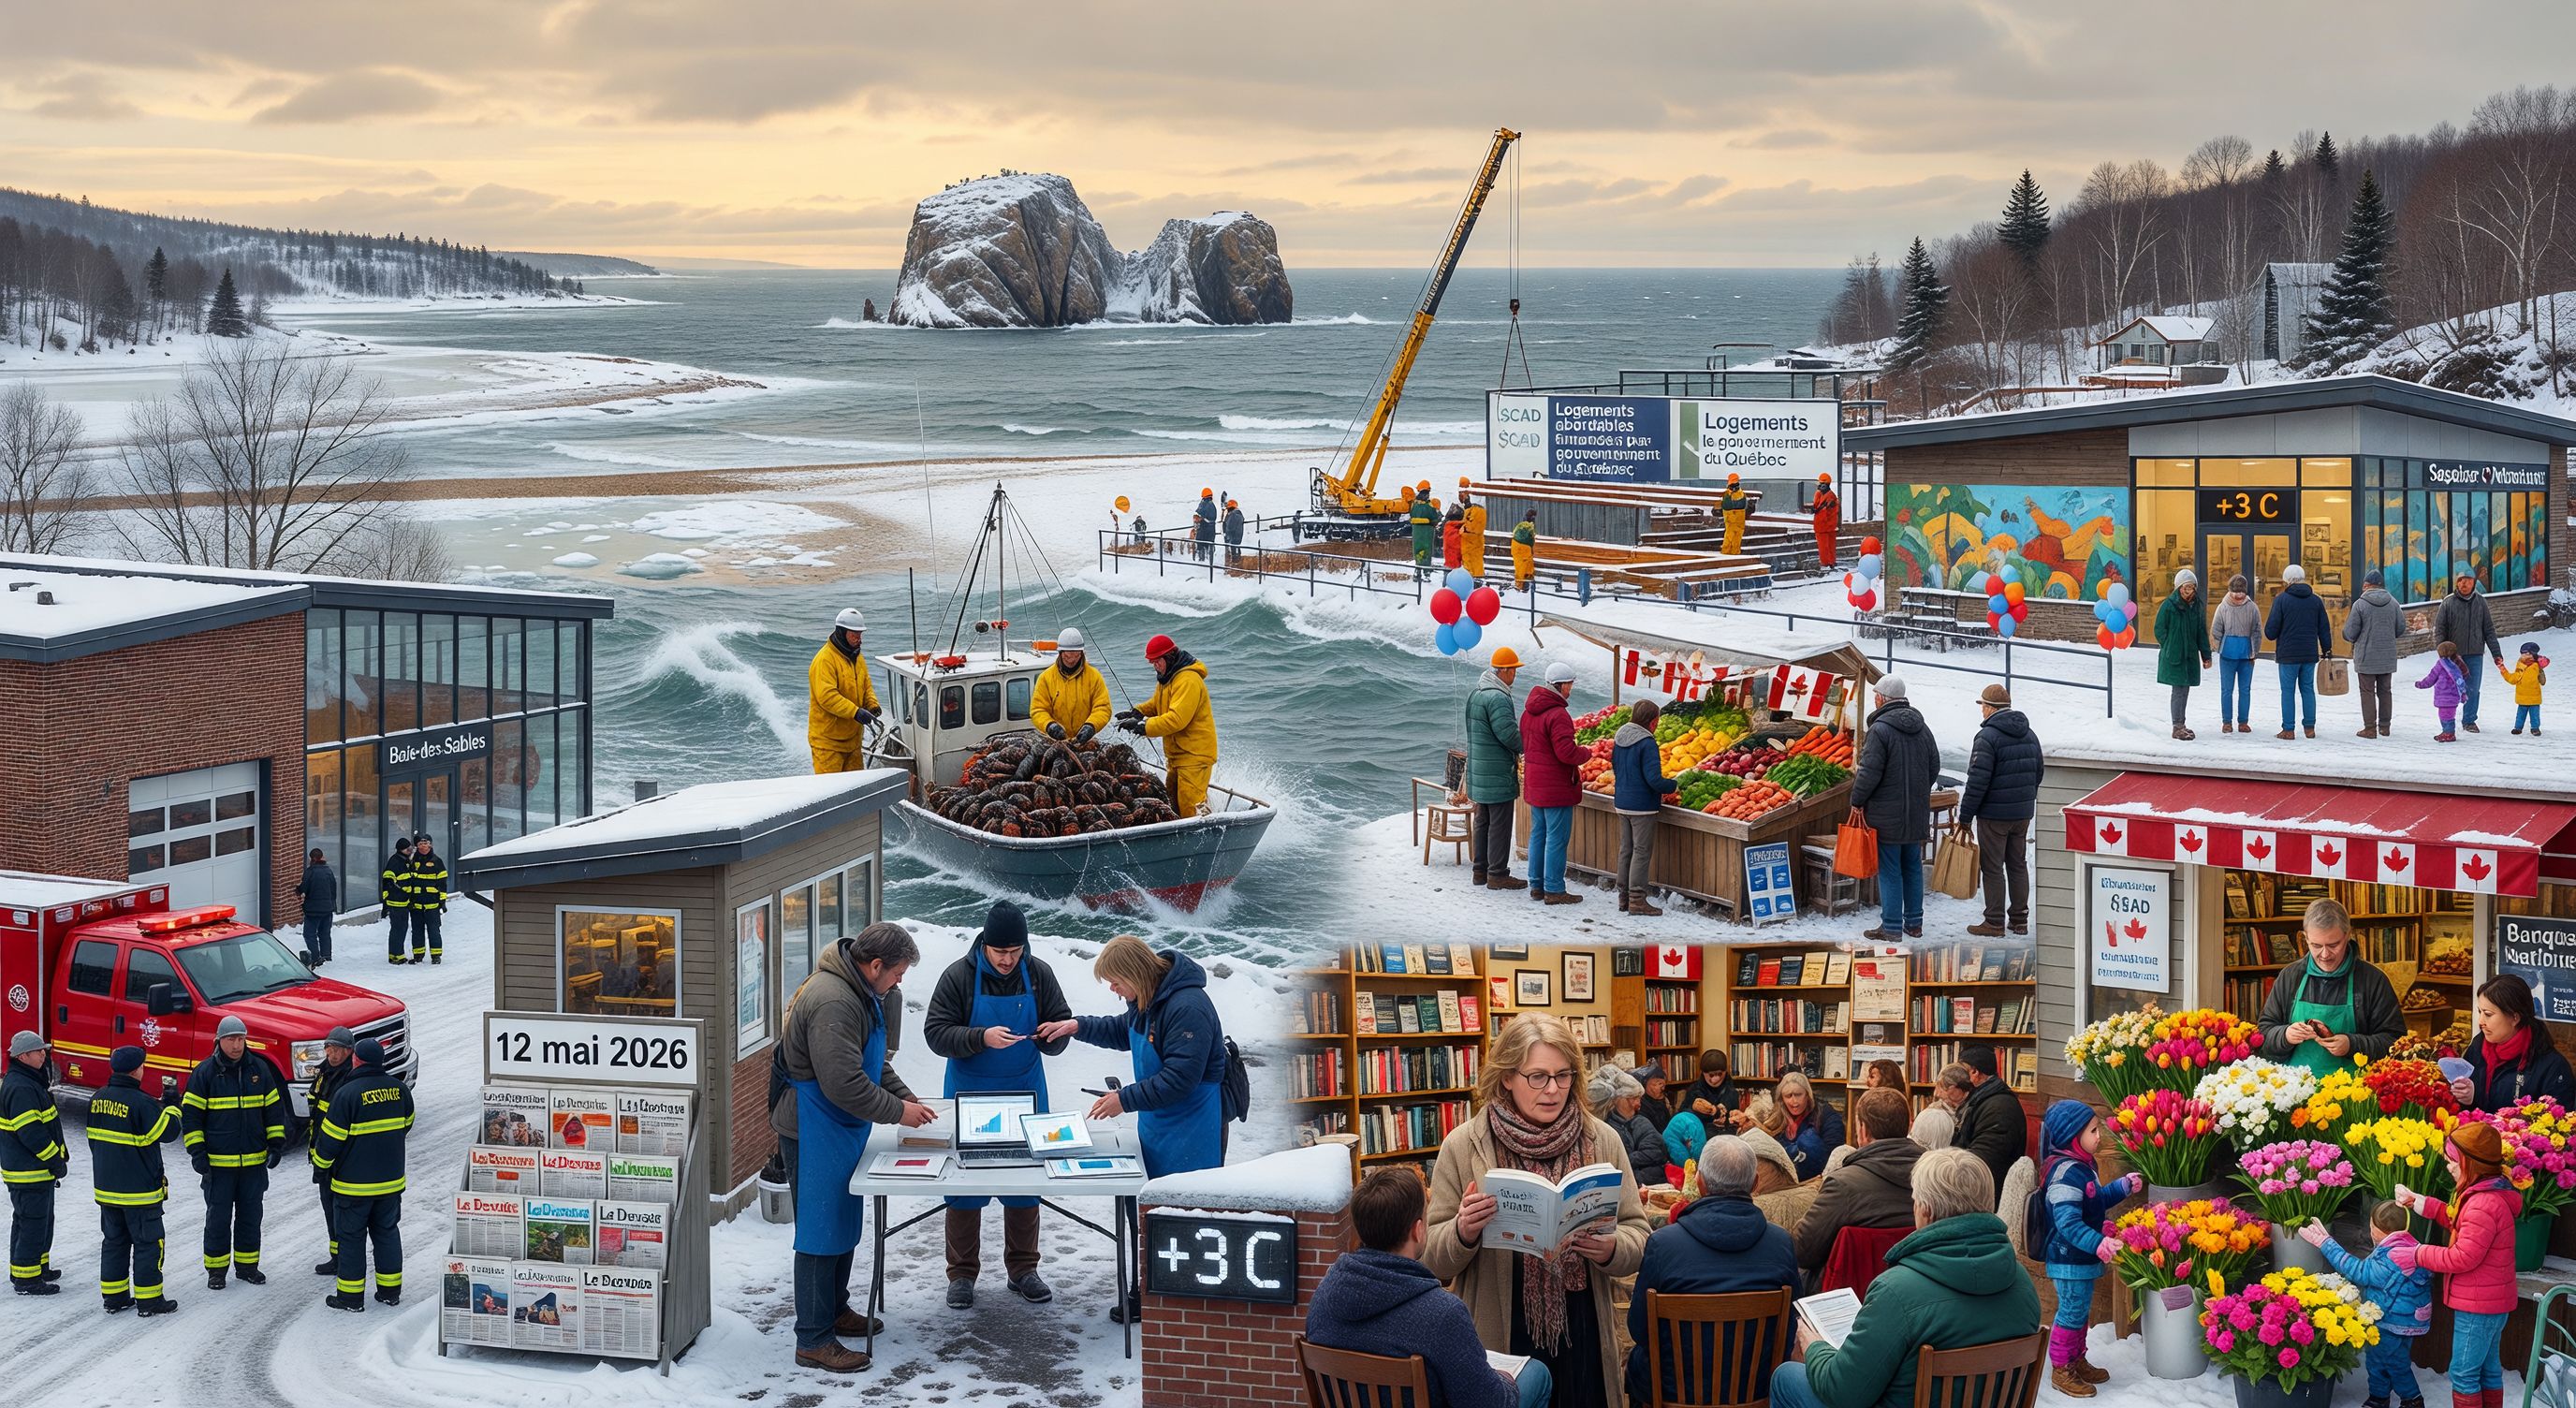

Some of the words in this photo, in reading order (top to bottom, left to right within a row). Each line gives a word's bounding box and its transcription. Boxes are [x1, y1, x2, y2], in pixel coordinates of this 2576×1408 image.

[1556, 403, 1634, 418] Logements
[1705, 413, 1808, 433] Logements
[2216, 492, 2251, 519] +3
[2260, 492, 2278, 519] C
[496, 1032, 532, 1063] 12
[542, 1034, 599, 1065] mai
[609, 1035, 688, 1069] 2026
[1157, 1228, 1228, 1284] +3
[1246, 1231, 1281, 1289] C
